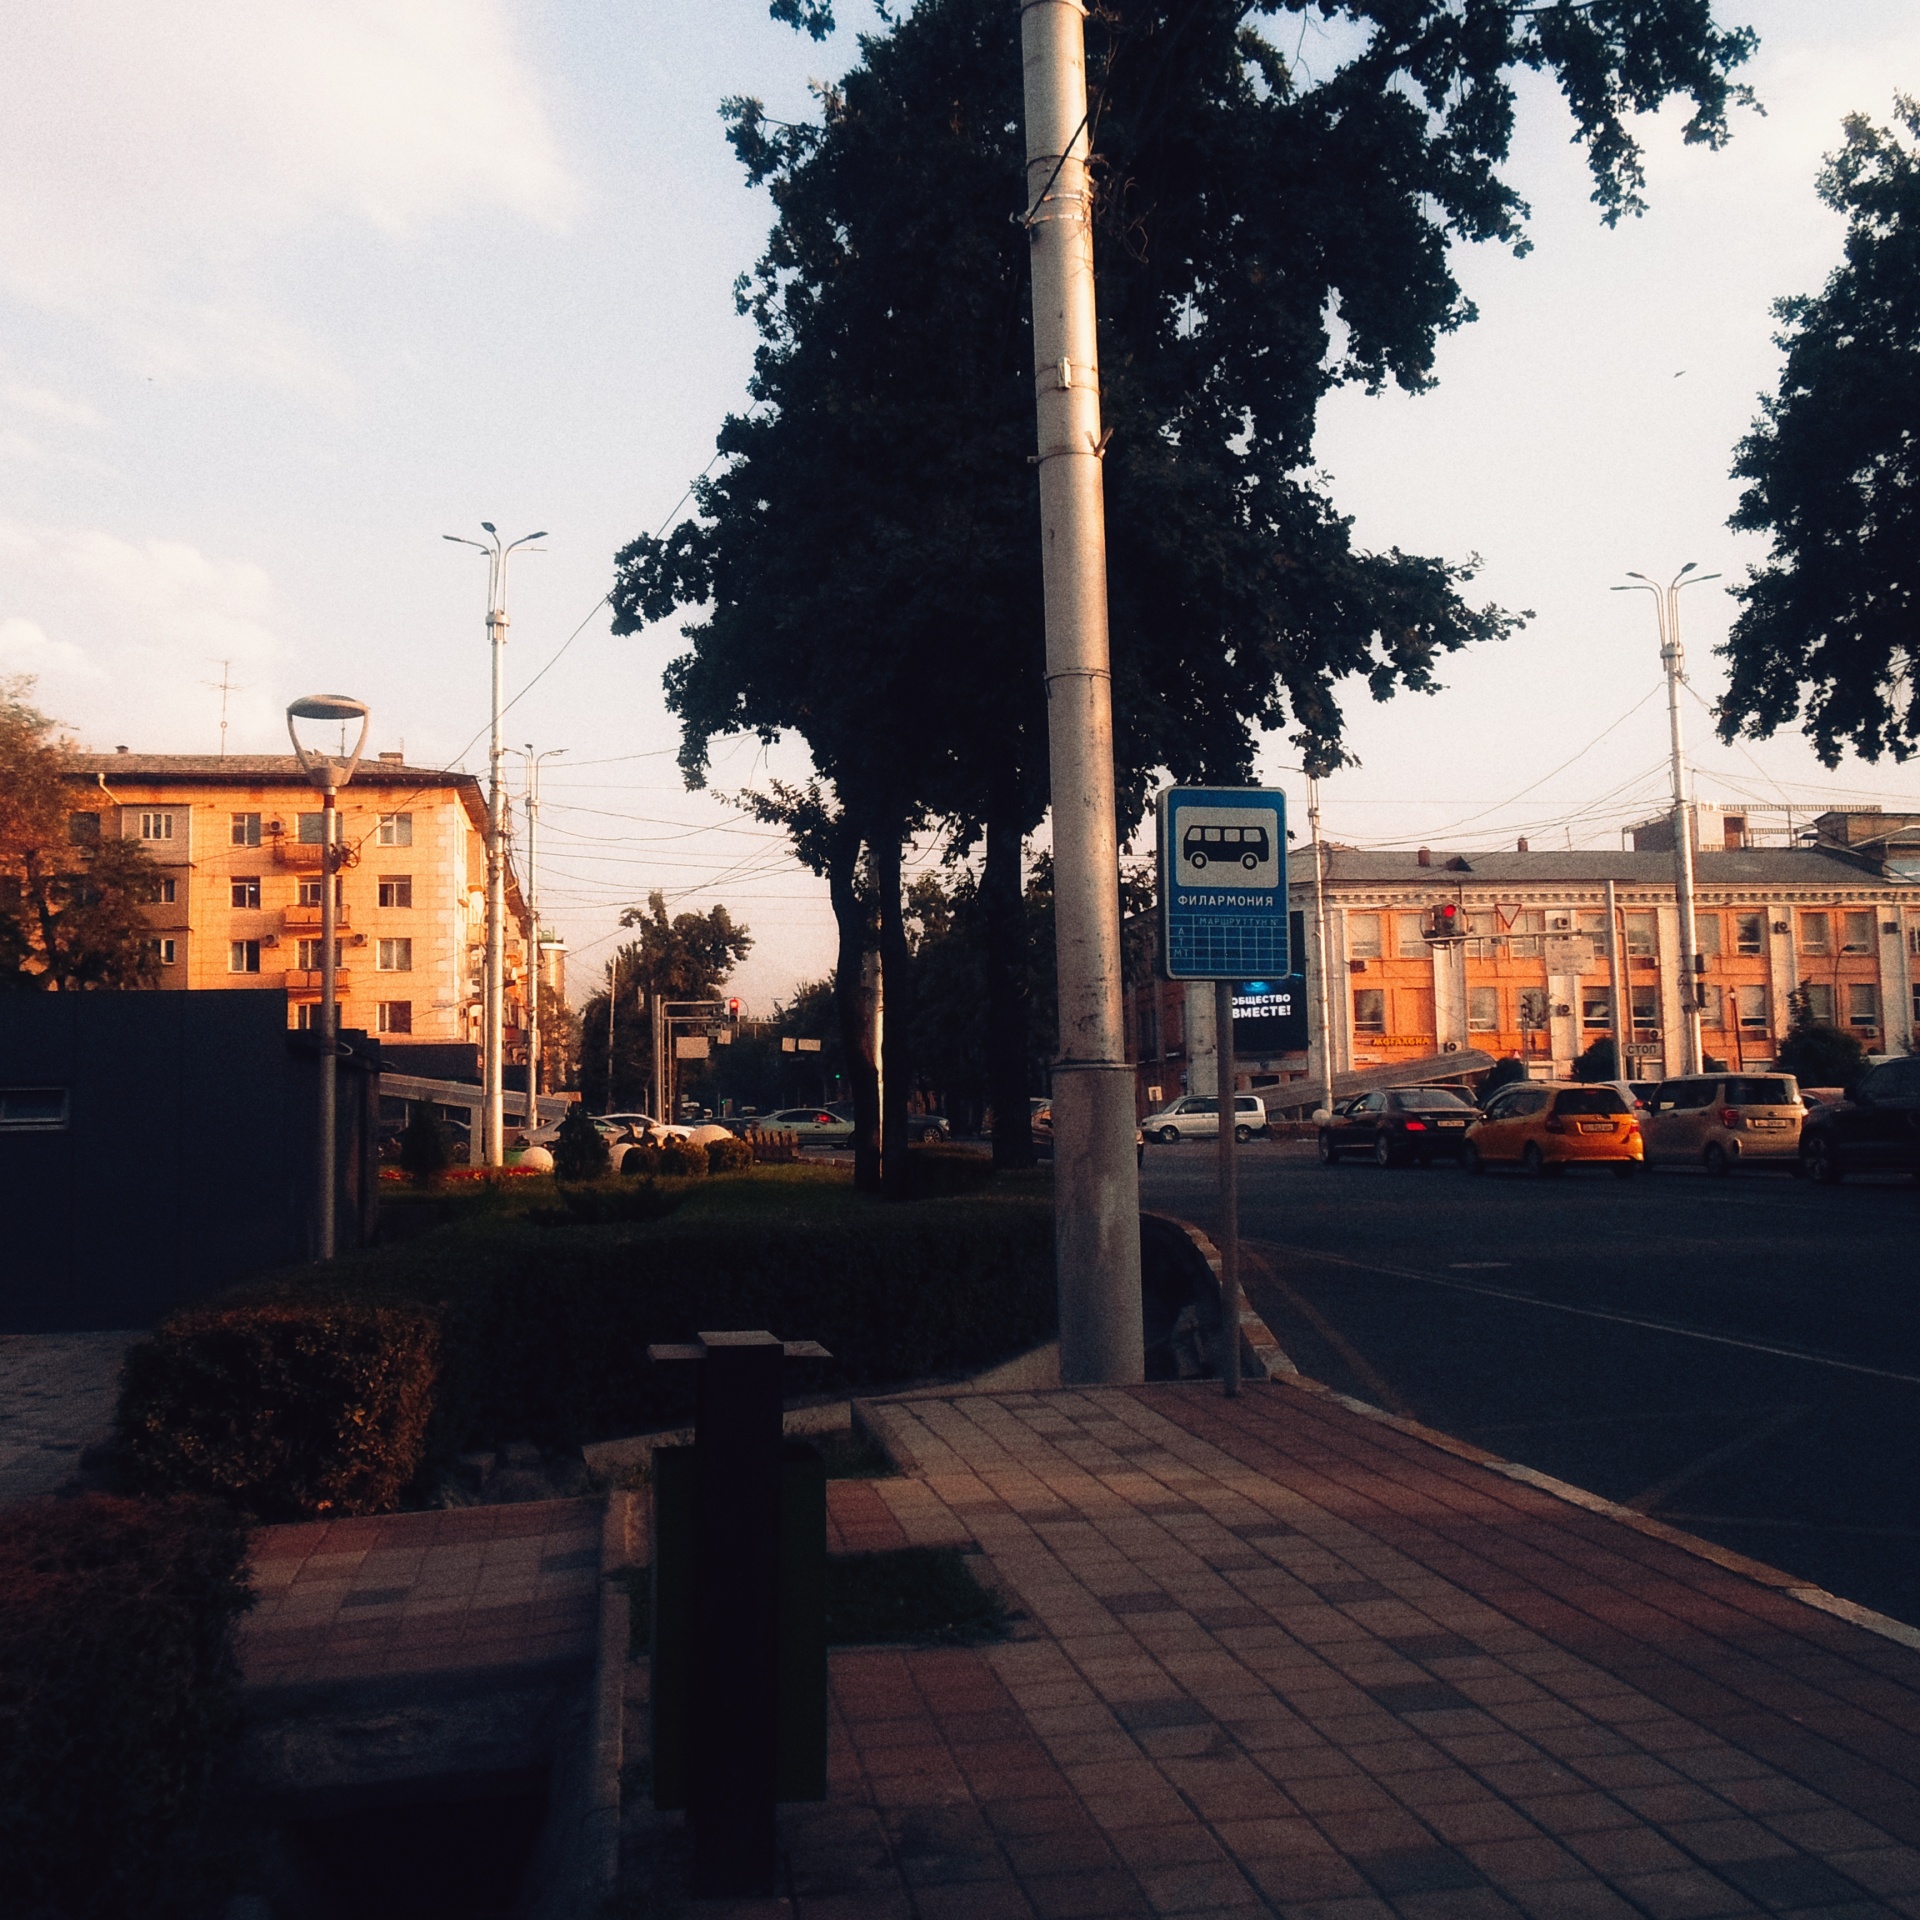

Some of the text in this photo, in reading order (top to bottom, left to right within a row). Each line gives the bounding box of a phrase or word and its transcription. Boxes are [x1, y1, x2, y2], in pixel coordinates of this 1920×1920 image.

[1178, 895, 1273, 906] ФИЛАРМОНИЯ
[1232, 1005, 1291, 1018] ВМЕСТЕ!
[1627, 1044, 1656, 1054] СТОП
